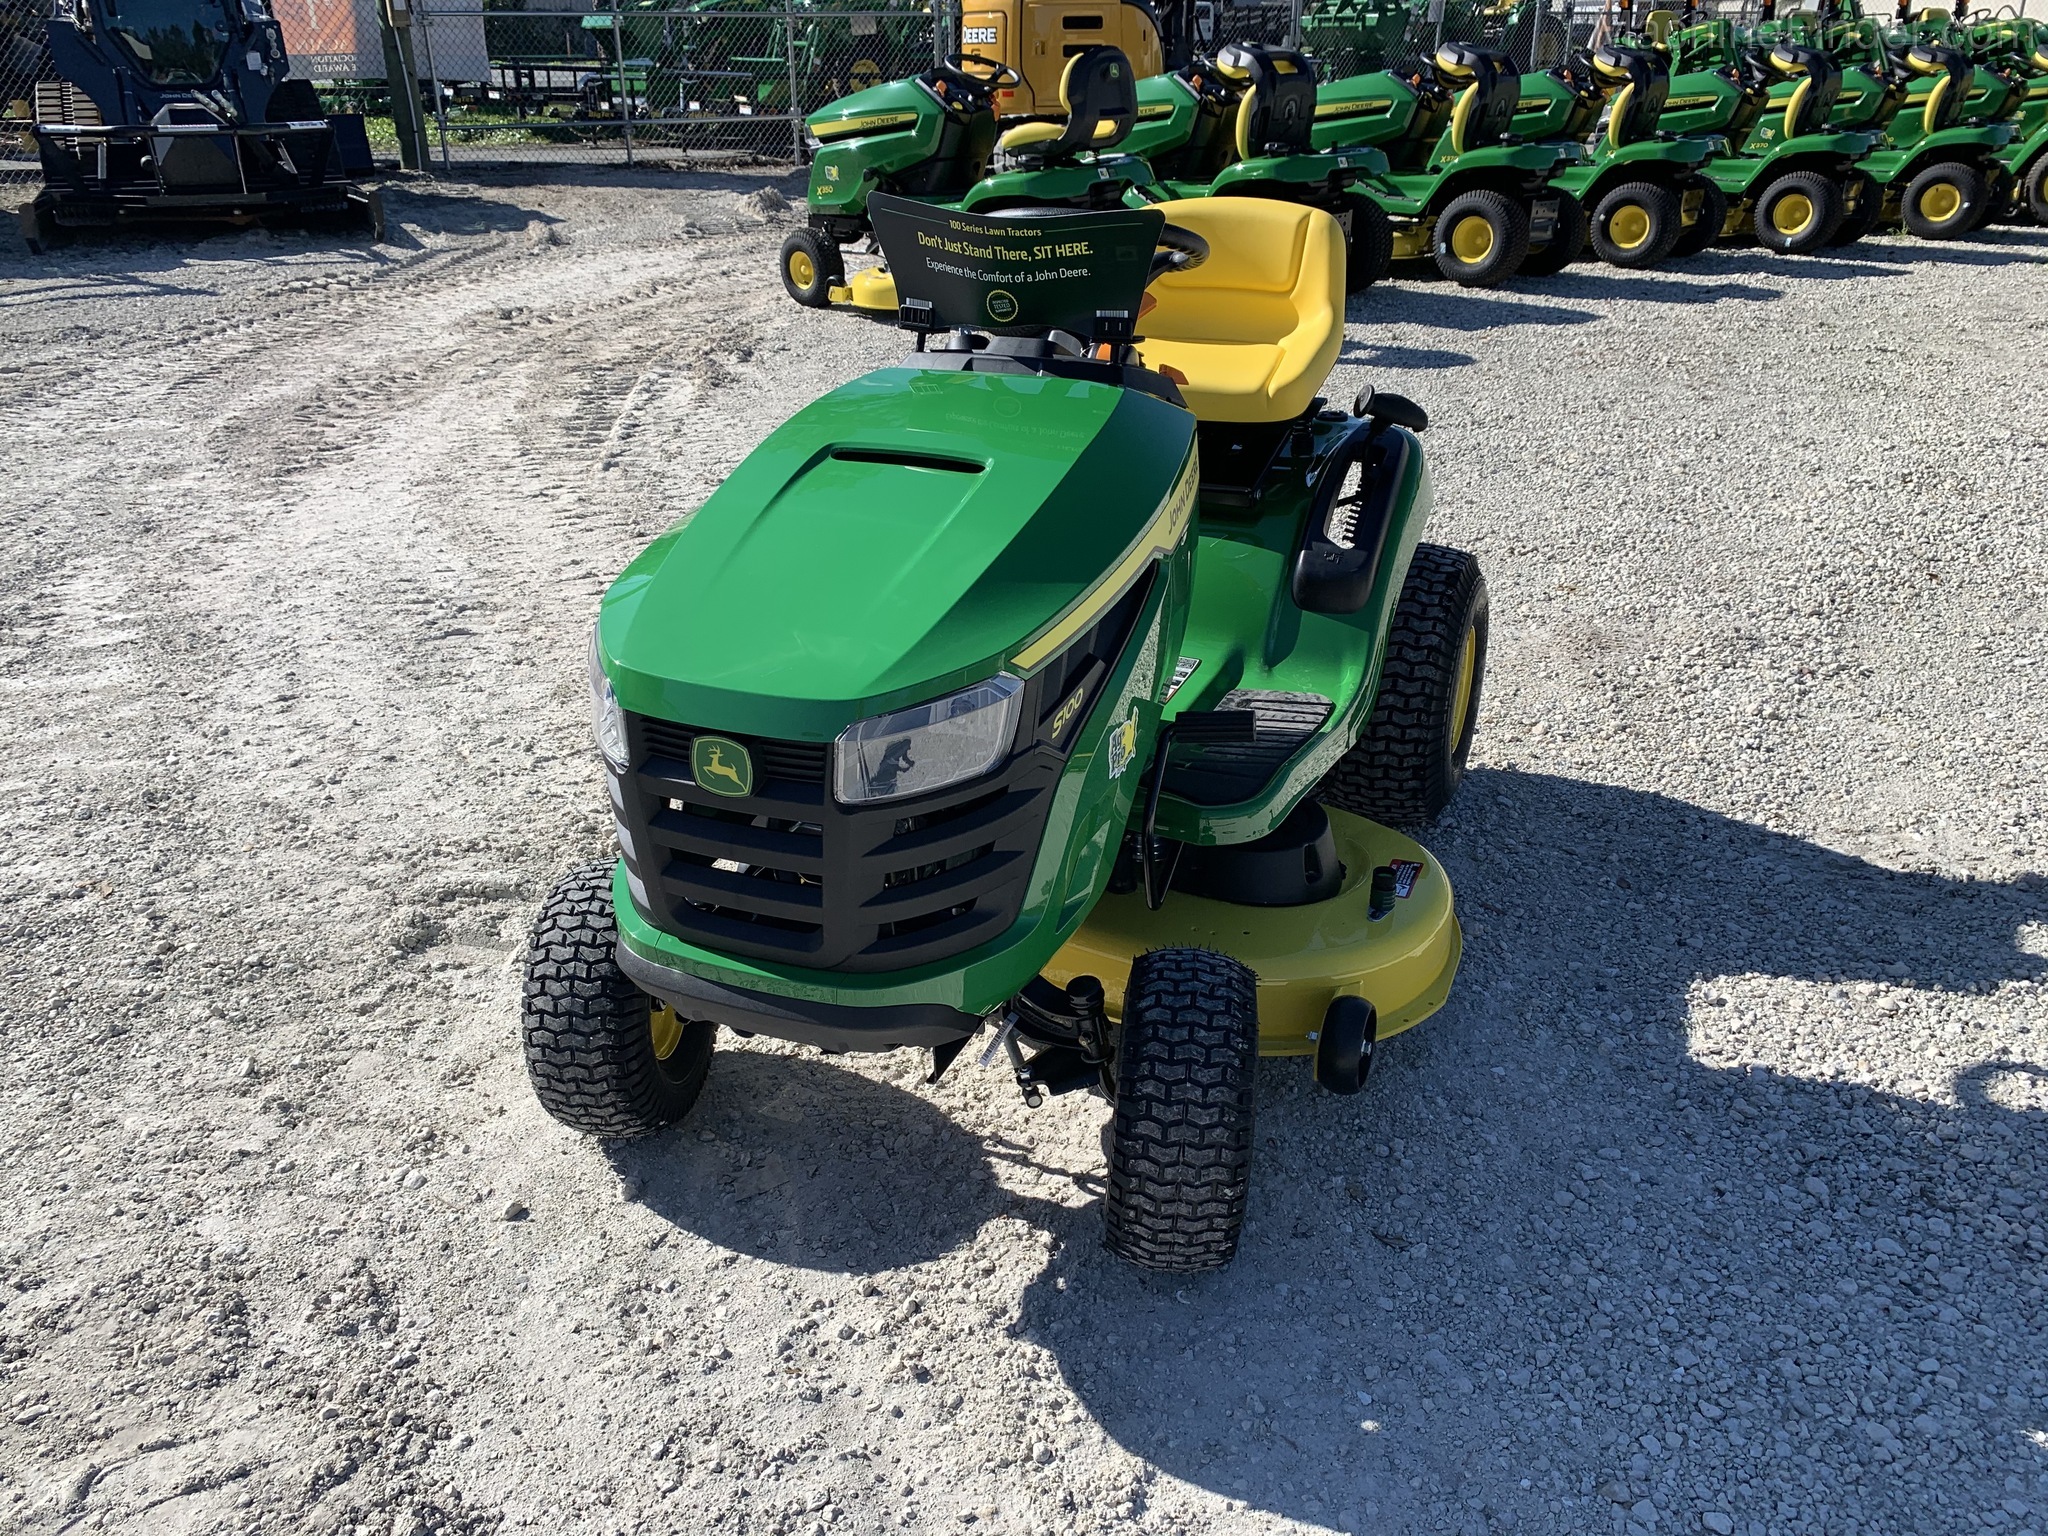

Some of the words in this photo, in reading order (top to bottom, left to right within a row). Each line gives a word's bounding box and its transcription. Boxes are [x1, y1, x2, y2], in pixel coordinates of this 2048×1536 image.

[860, 119, 877, 129] JOHN
[877, 116, 899, 126] DEERE
[948, 219, 961, 231] 100
[961, 222, 984, 235] Series
[984, 225, 1006, 237] Lawn
[1006, 227, 1042, 237] Tractors
[917, 231, 943, 250] Don't
[944, 237, 963, 254] Just
[962, 241, 993, 259] Stand
[994, 245, 1032, 262] There,
[1033, 245, 1053, 260] SIT
[1055, 241, 1094, 258] HERE.
[926, 256, 964, 277] Experience
[964, 266, 977, 280] the
[977, 269, 1013, 283] Comfort
[1014, 271, 1025, 283] of
[1026, 274, 1033, 282] a
[1035, 269, 1058, 282] John
[1059, 267, 1091, 279] Deere.
[1168, 490, 1186, 536] JOHN
[1052, 688, 1084, 740] S100
